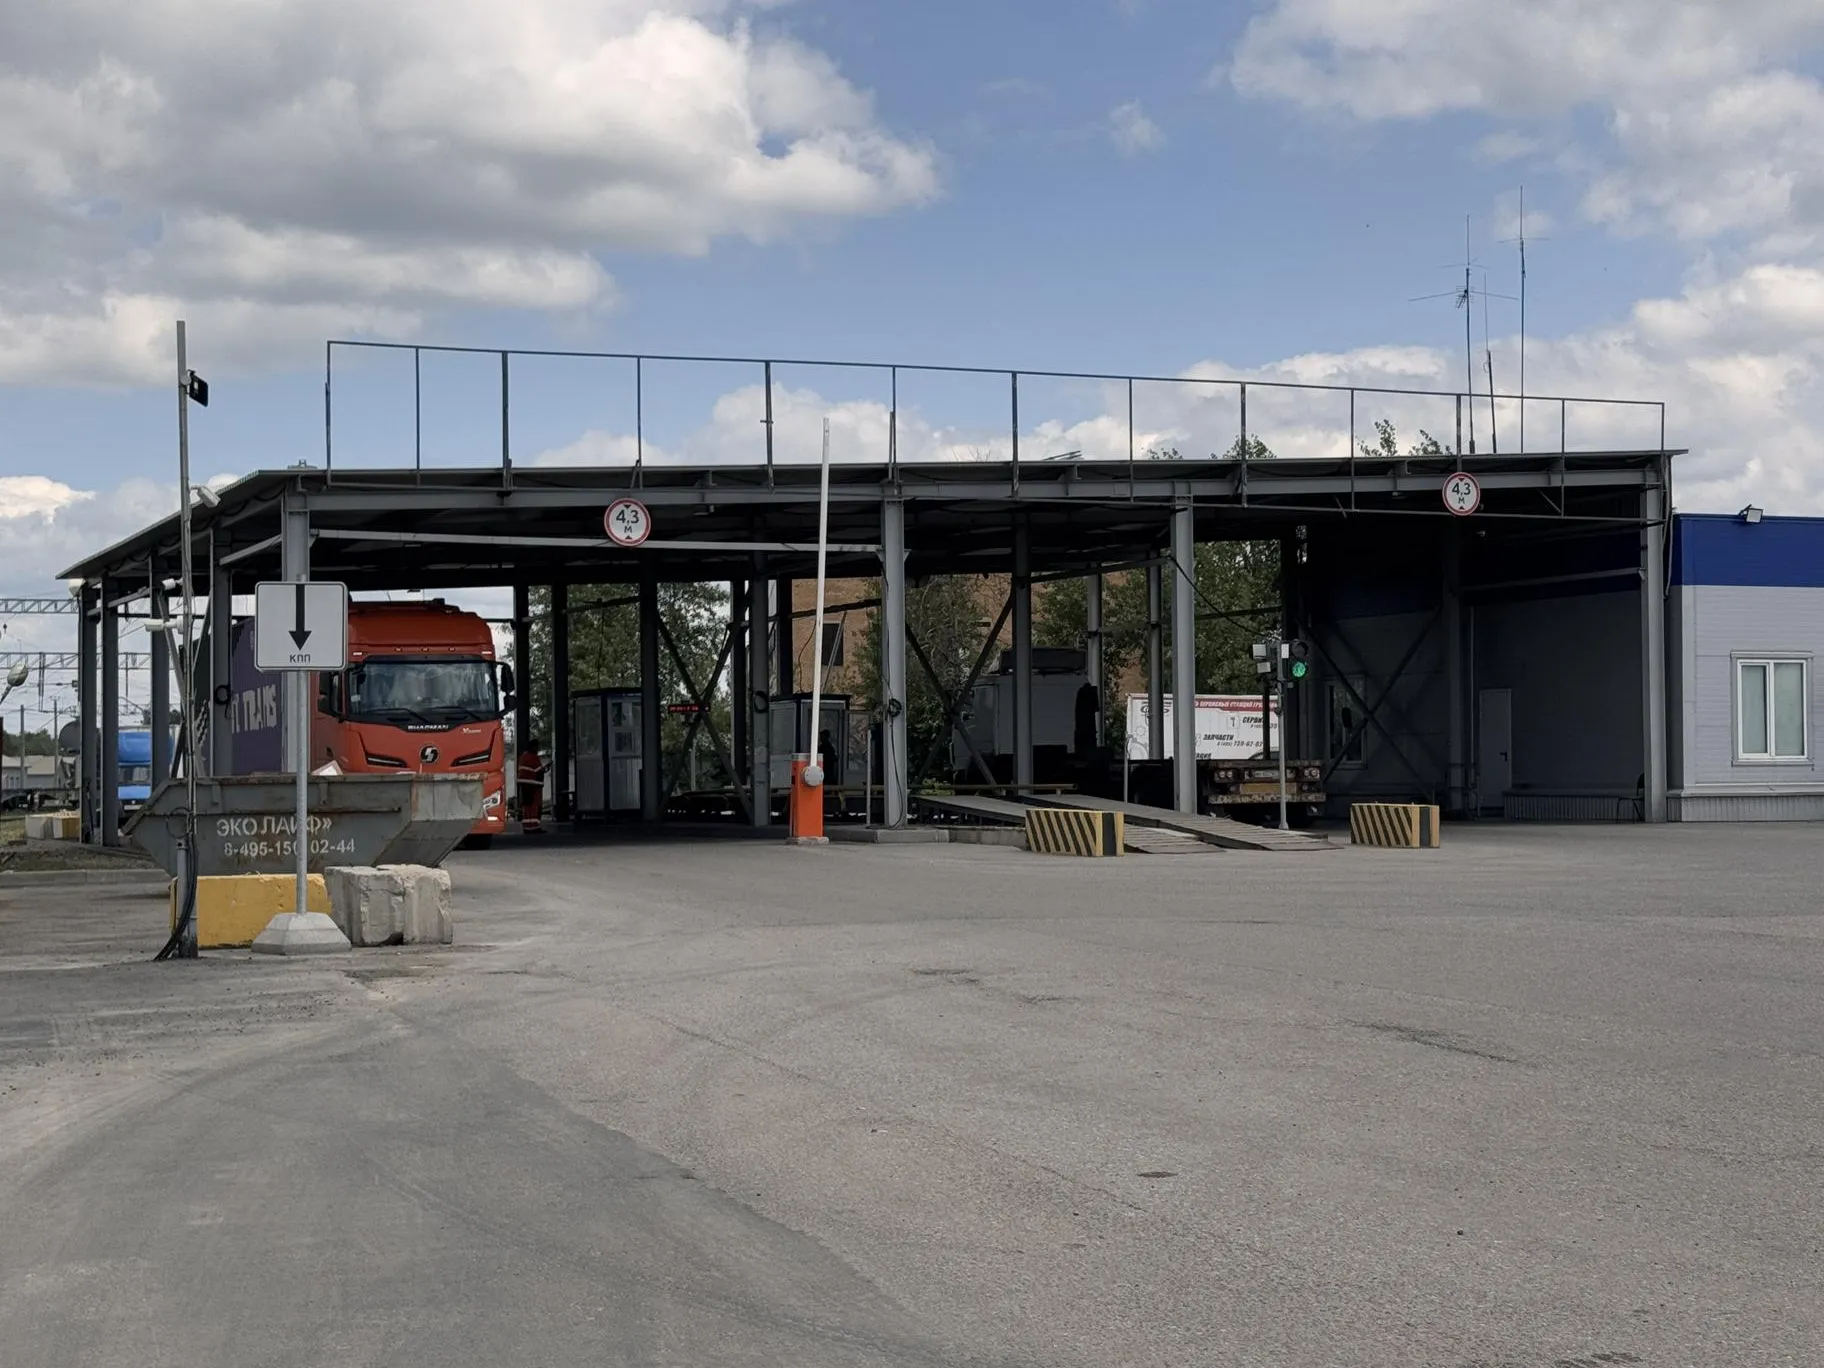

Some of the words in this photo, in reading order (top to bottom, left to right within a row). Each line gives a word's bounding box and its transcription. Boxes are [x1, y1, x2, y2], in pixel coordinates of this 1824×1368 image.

[1452, 482, 1471, 496] 4,3
[616, 509, 639, 525] 4,3
[289, 654, 311, 664] КПП
[216, 817, 258, 837] ЭКО
